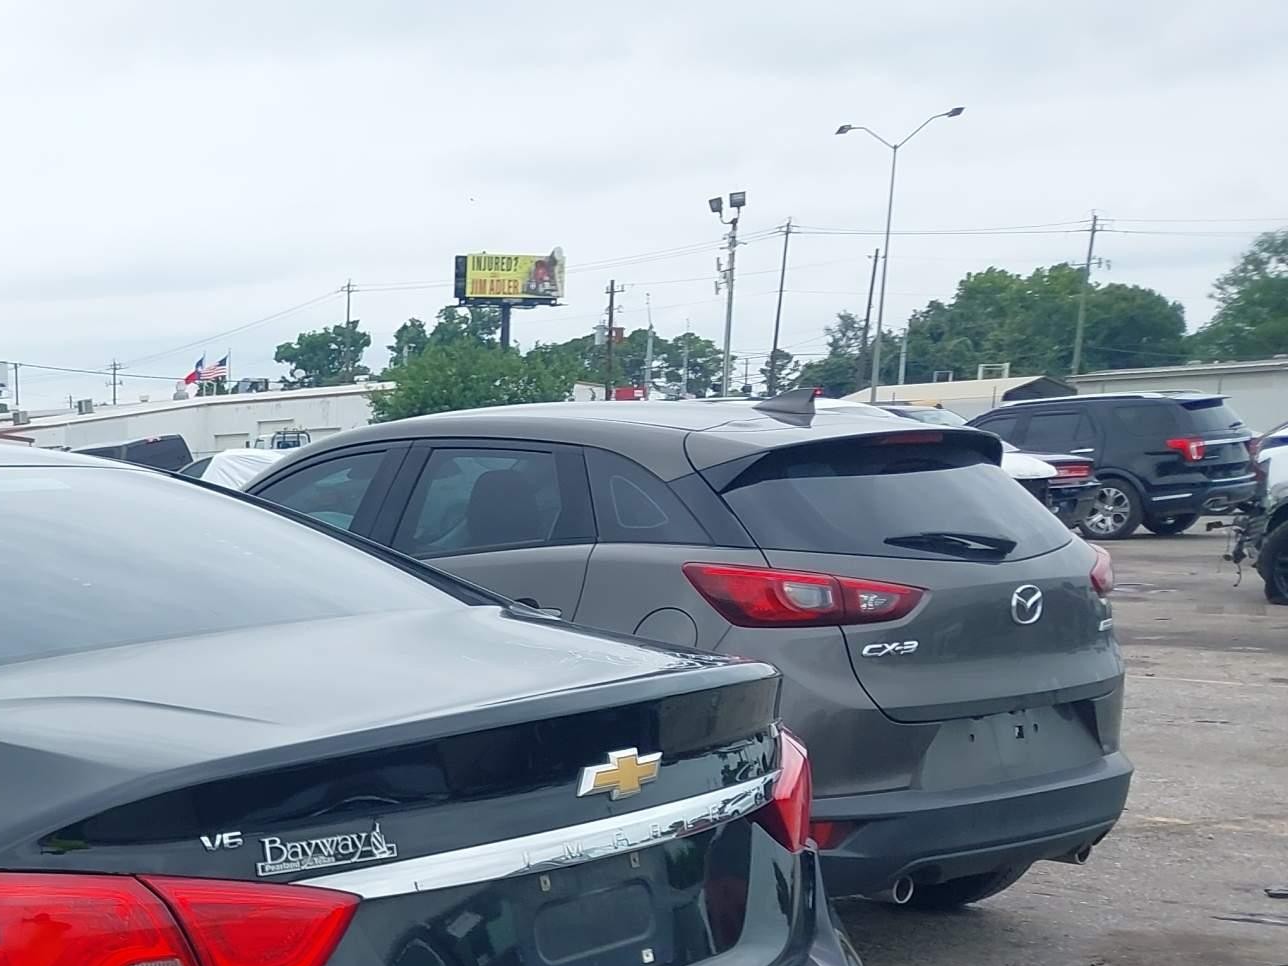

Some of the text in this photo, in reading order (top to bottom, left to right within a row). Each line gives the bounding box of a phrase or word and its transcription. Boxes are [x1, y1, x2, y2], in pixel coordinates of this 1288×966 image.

[472, 256, 519, 271] INJURED?
[470, 279, 520, 295] JIM ADLER
[862, 640, 919, 657] CX-3
[260, 832, 368, 869] Bayway
